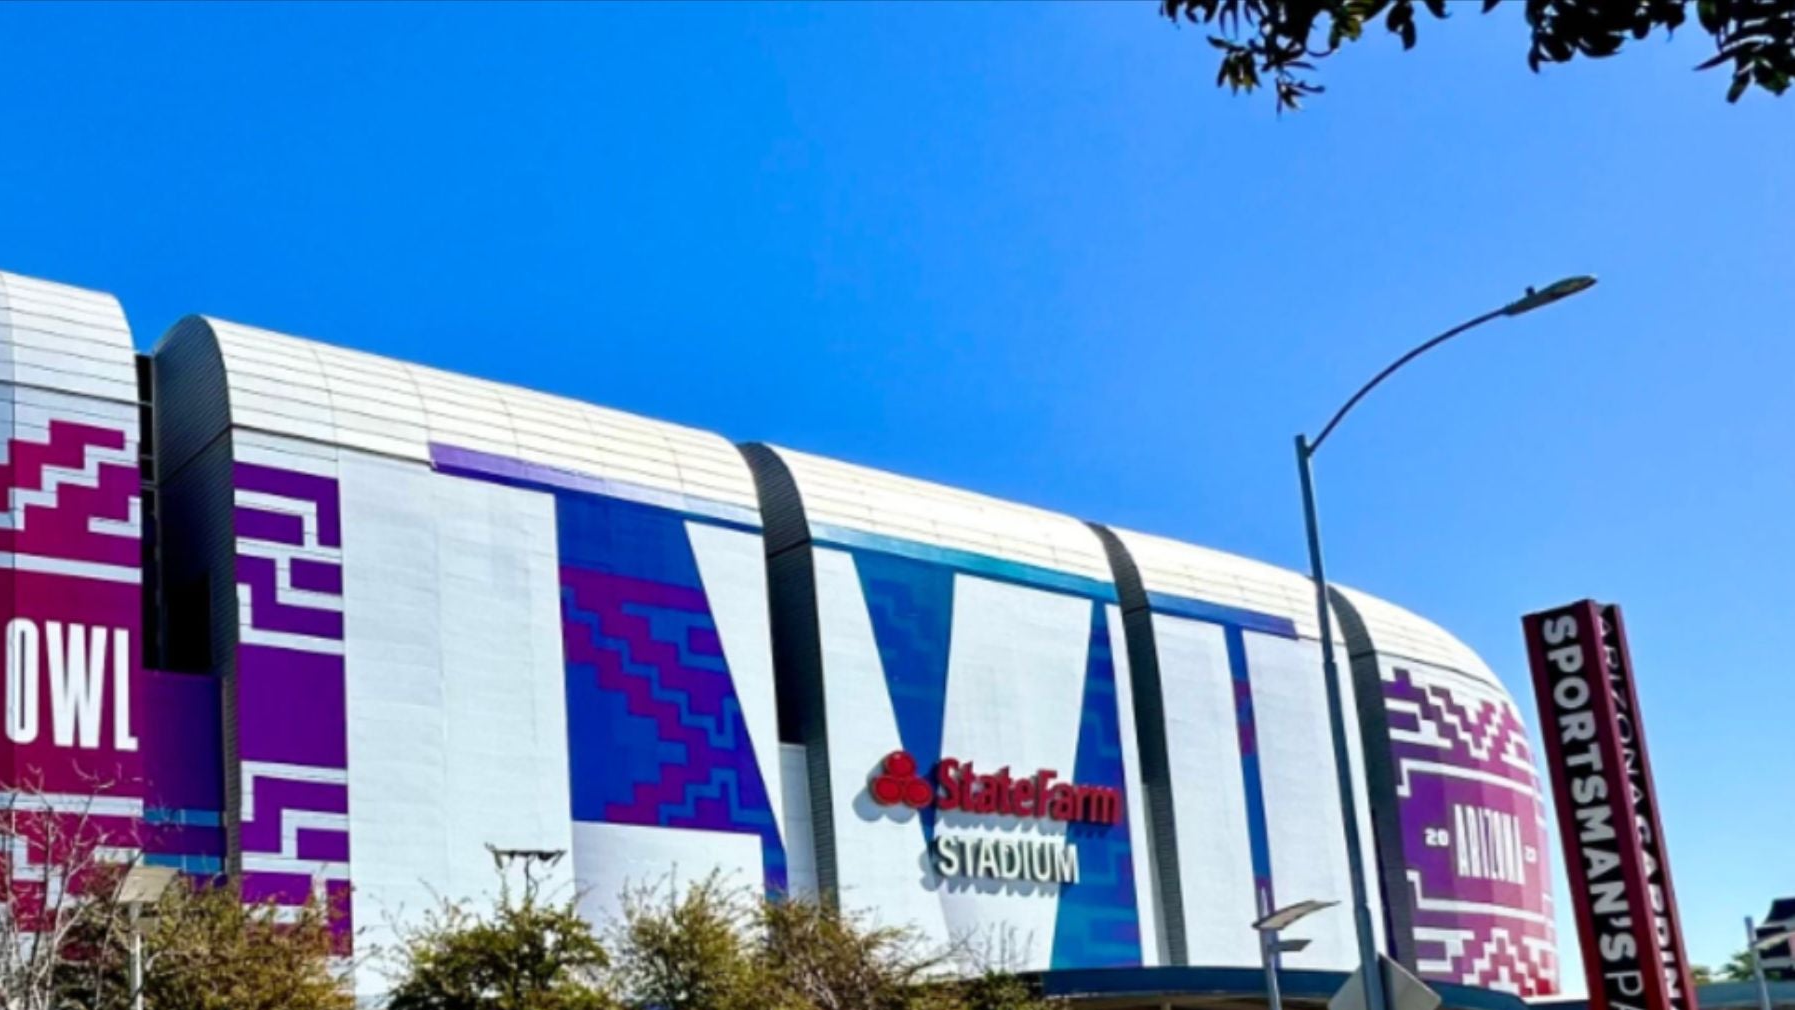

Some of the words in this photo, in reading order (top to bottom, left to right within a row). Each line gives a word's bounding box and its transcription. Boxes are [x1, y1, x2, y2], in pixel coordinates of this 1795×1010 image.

[1597, 615, 1644, 805] ARIZONA
[1454, 803, 1526, 885] ARIZONA
[1542, 614, 1637, 962] SPORTSMAN'S
[937, 834, 1080, 885] STADIUM
